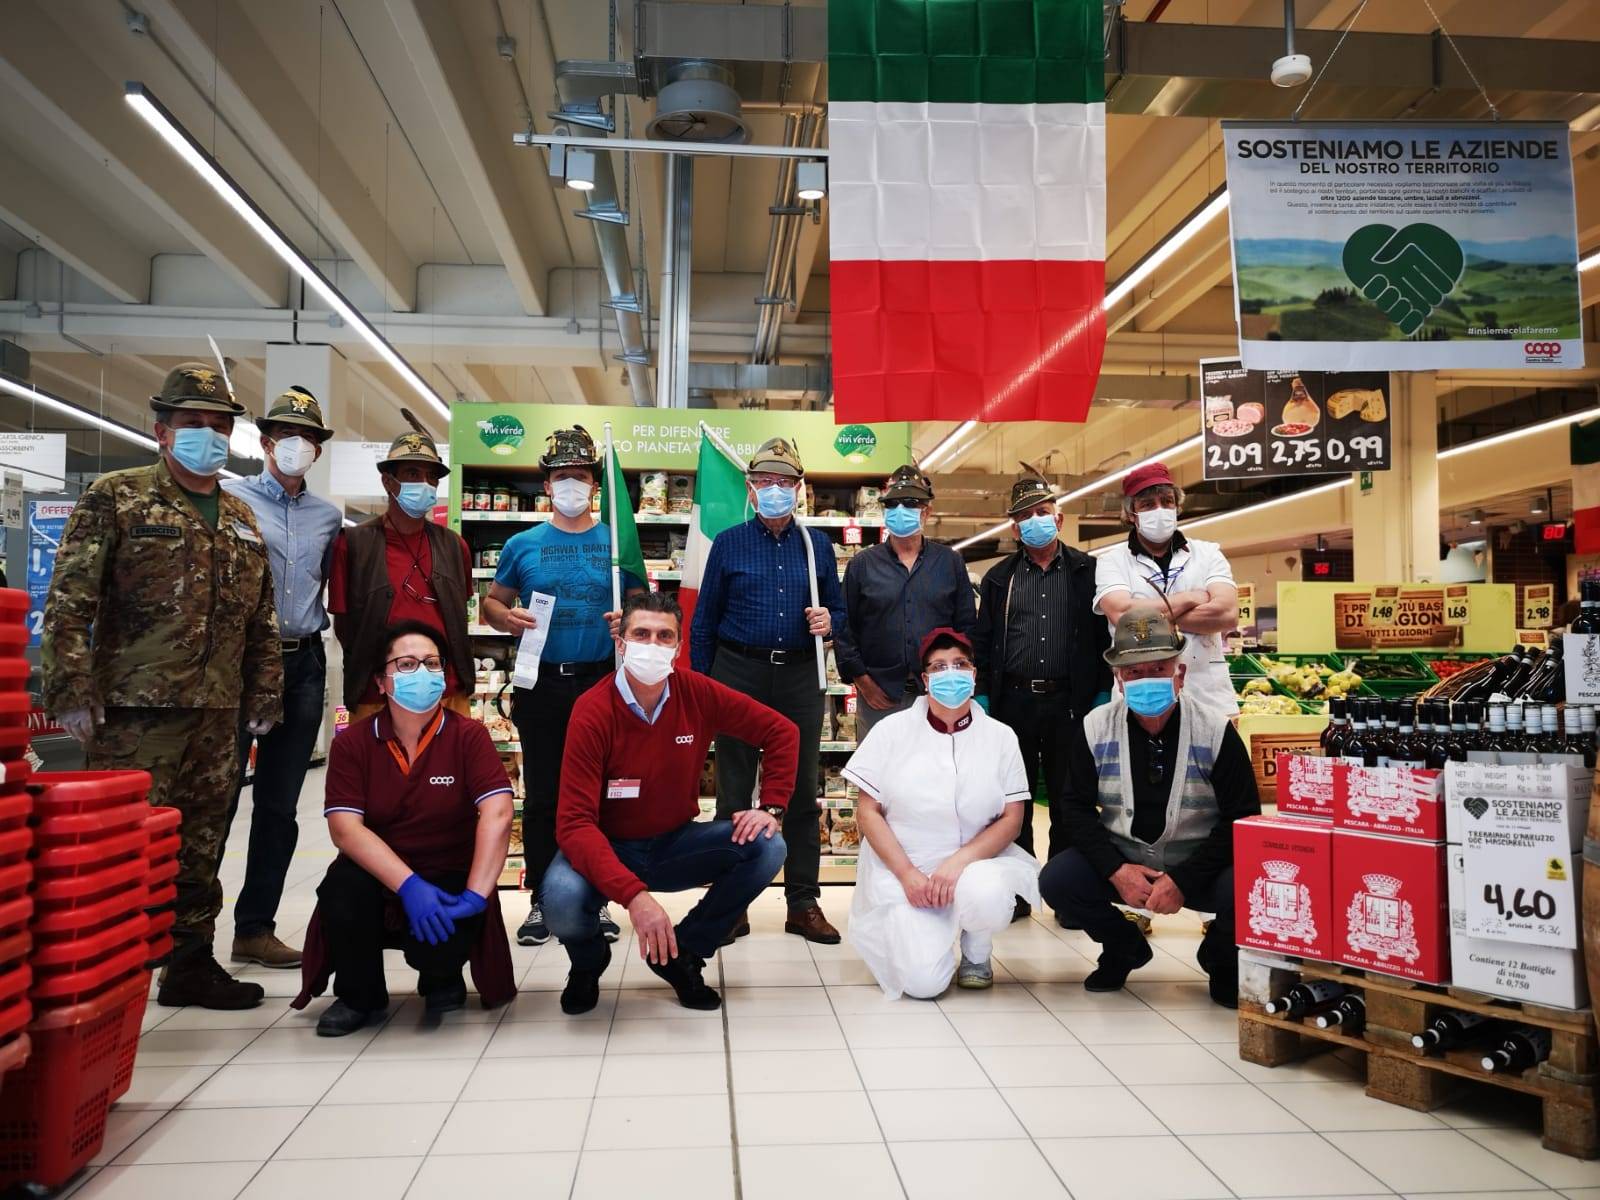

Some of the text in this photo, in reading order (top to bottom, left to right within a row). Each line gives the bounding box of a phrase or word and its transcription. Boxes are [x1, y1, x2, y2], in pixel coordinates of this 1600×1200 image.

[1237, 139, 1559, 160] SOSTENIAMO LE AZIENDE
[1300, 162, 1499, 174] DEL NOSTRO TERRITORIO
[1524, 342, 1562, 358] coop
[500, 424, 523, 435] verde
[633, 424, 731, 439] PER DIFENRE
[838, 433, 875, 444] vivi verde
[637, 441, 692, 454] PIANETA
[1270, 438, 1322, 467] 2,75
[1326, 435, 1383, 464] 0,99
[1207, 442, 1262, 471] 2,09
[41, 505, 75, 515] OFFER
[541, 544, 578, 555] HIGHWAY
[1345, 612, 1443, 628] DI GION
[1526, 607, 1550, 620] 2.98
[1365, 629, 1390, 638] TUTTI
[1398, 628, 1433, 637] GIORNI
[675, 734, 694, 746] coop
[1264, 760, 1277, 777] D
[429, 775, 455, 787] coop
[1484, 772, 1508, 780] WEIGHT
[1286, 803, 1309, 811] PESCARA
[1491, 799, 1563, 811] SOSTENIAMO
[1495, 808, 1560, 819] LE AZIENDE
[1343, 819, 1425, 835] PESCARA ABRUZZO ITALIA
[1483, 883, 1557, 921] 4,60
[1246, 936, 1322, 956] PESCARA ABRUZZO ITALIA
[1343, 953, 1425, 977] PESCARA ABRUZZO ITALIA
[1469, 953, 1557, 976] Contiene 12 Bottiglie
[1497, 968, 1527, 980] di vino
[1506, 978, 1530, 990] 0,750
